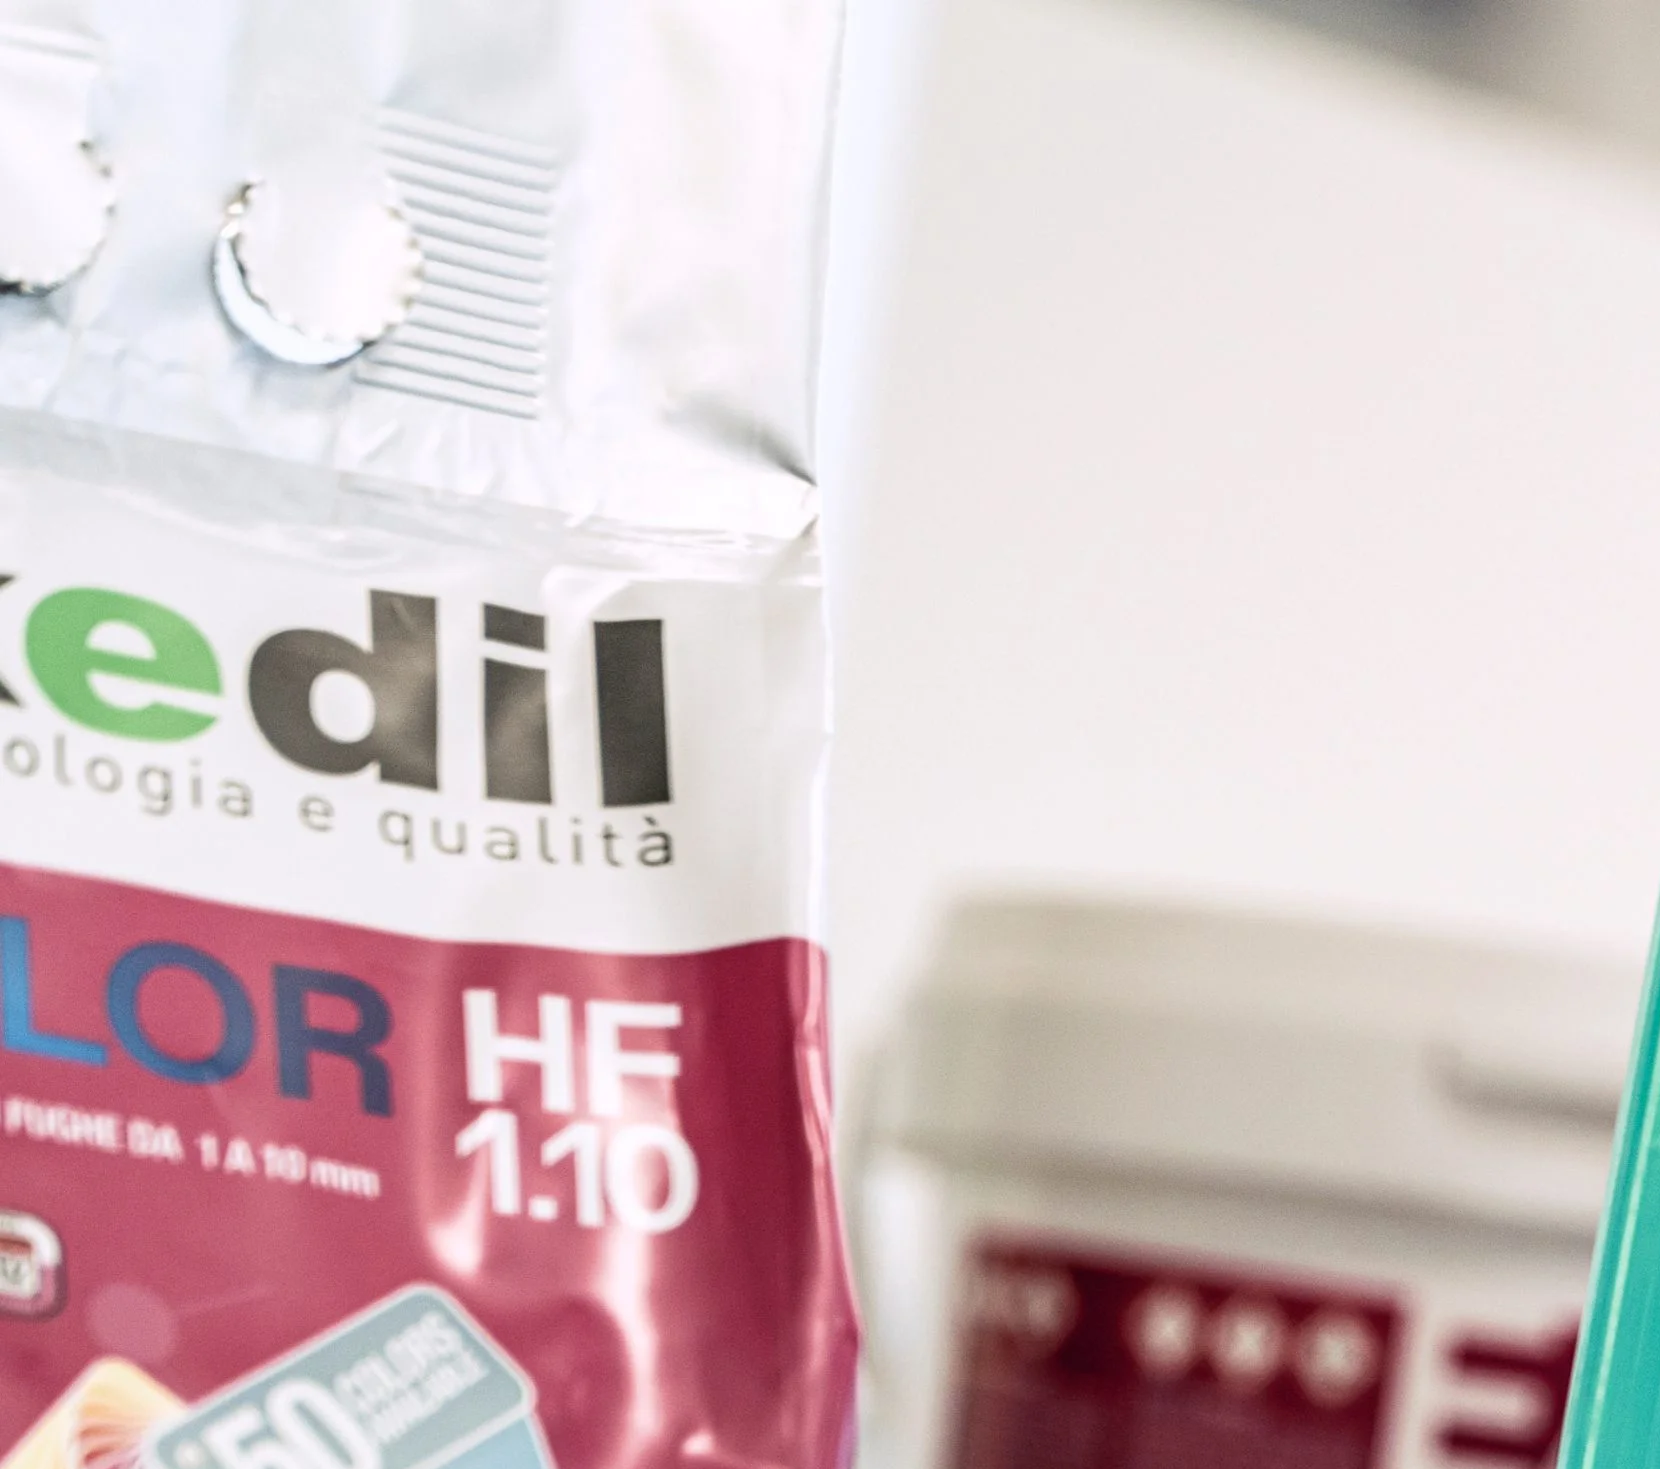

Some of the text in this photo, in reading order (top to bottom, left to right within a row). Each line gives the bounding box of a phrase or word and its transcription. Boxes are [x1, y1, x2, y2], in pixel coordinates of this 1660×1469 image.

[0, 573, 674, 808] edil
[298, 795, 335, 832] e
[378, 806, 675, 868] qualità
[462, 985, 683, 1118] HF
[223, 1136, 257, 1176] A
[308, 1157, 381, 1198] mm
[455, 1107, 700, 1237] 1.10
